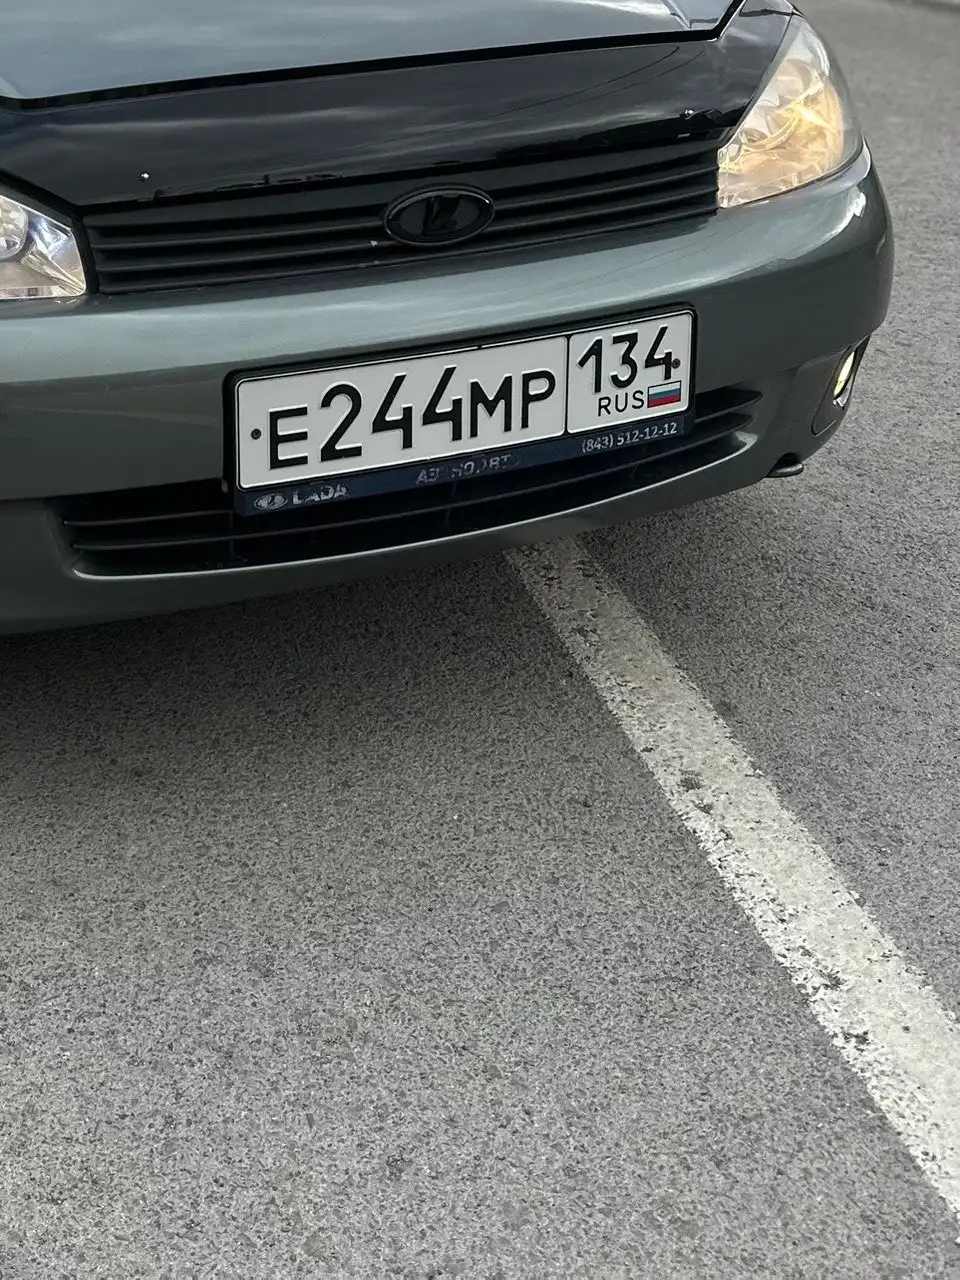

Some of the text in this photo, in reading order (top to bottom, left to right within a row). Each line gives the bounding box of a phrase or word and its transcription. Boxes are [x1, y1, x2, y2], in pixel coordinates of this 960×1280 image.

[577, 325, 673, 394] 134
[597, 390, 645, 417] RUS
[581, 422, 678, 453] (843) 512-12-12
